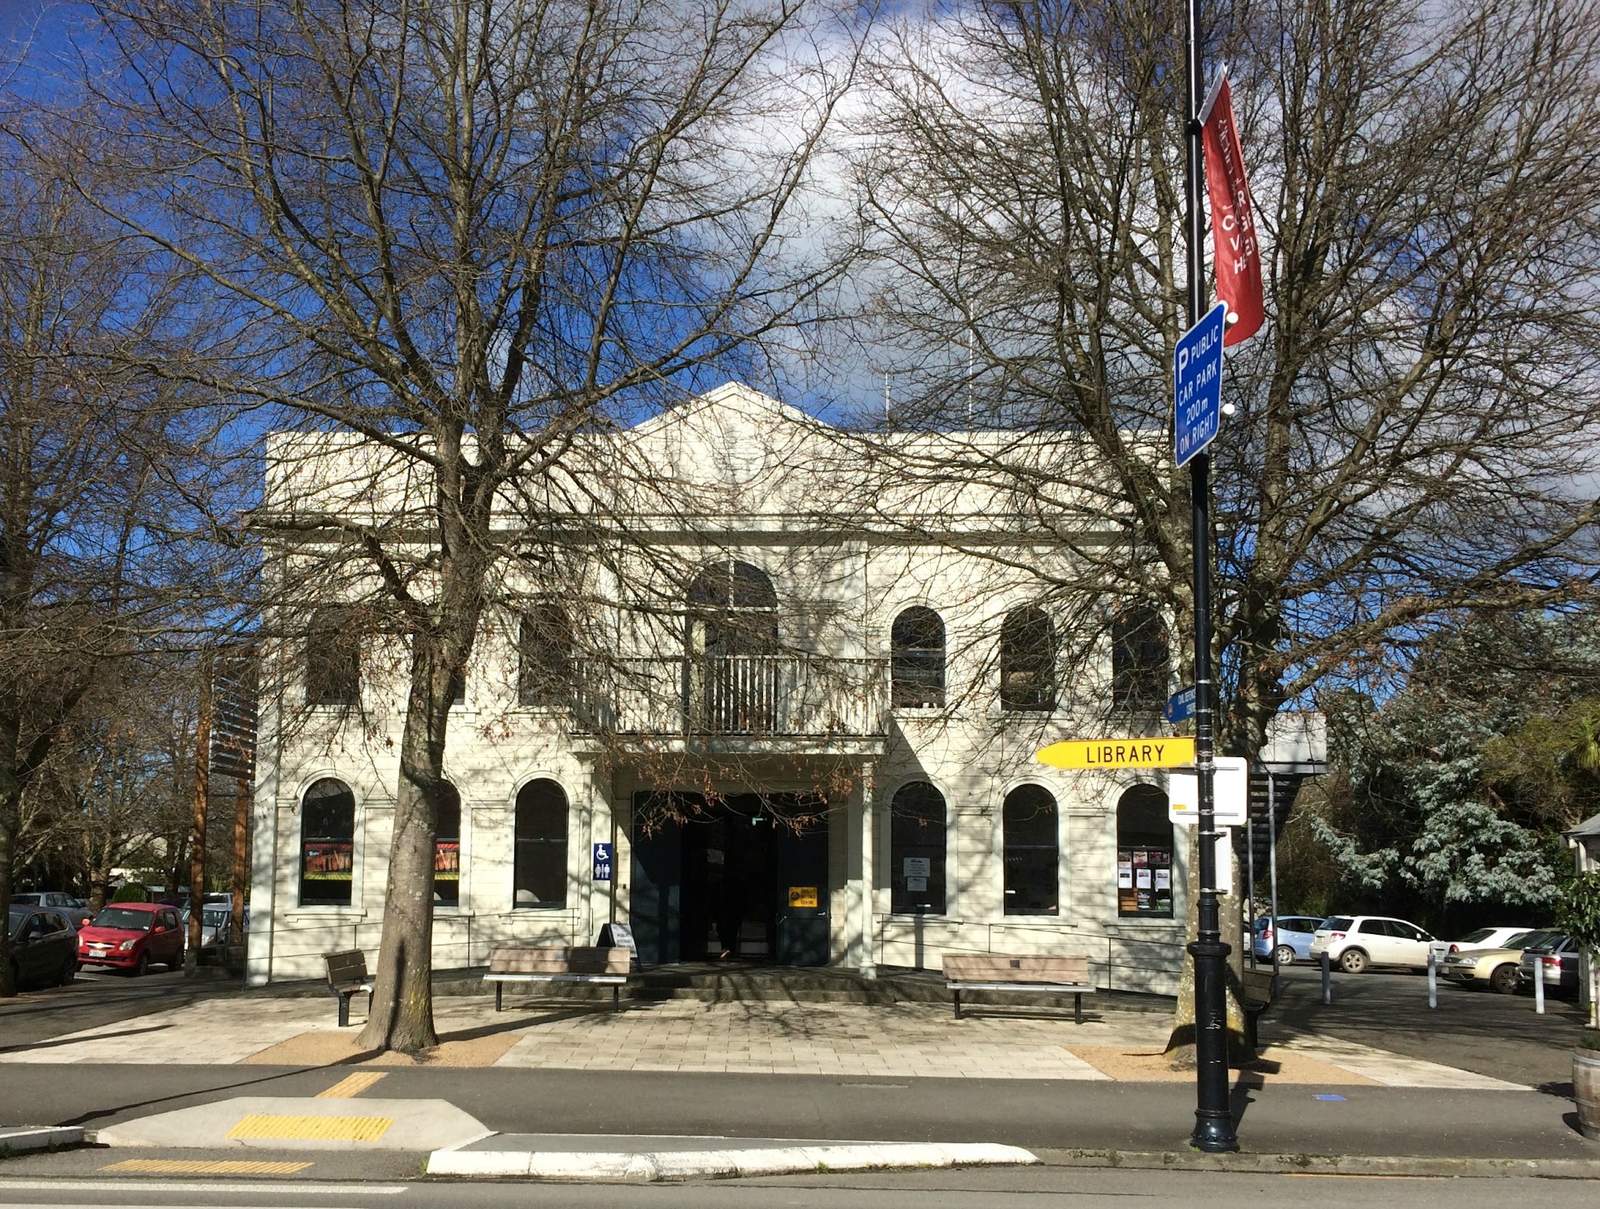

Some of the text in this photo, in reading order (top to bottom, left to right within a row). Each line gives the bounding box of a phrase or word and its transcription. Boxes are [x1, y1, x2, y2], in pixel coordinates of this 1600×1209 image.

[1179, 325, 1218, 384] P PUBLIC
[1179, 358, 1217, 407] CAR PARK
[1180, 411, 1214, 455] ON RIGHT
[1186, 399, 1200, 426] 200
[1087, 745, 1164, 763] LIBRARY
